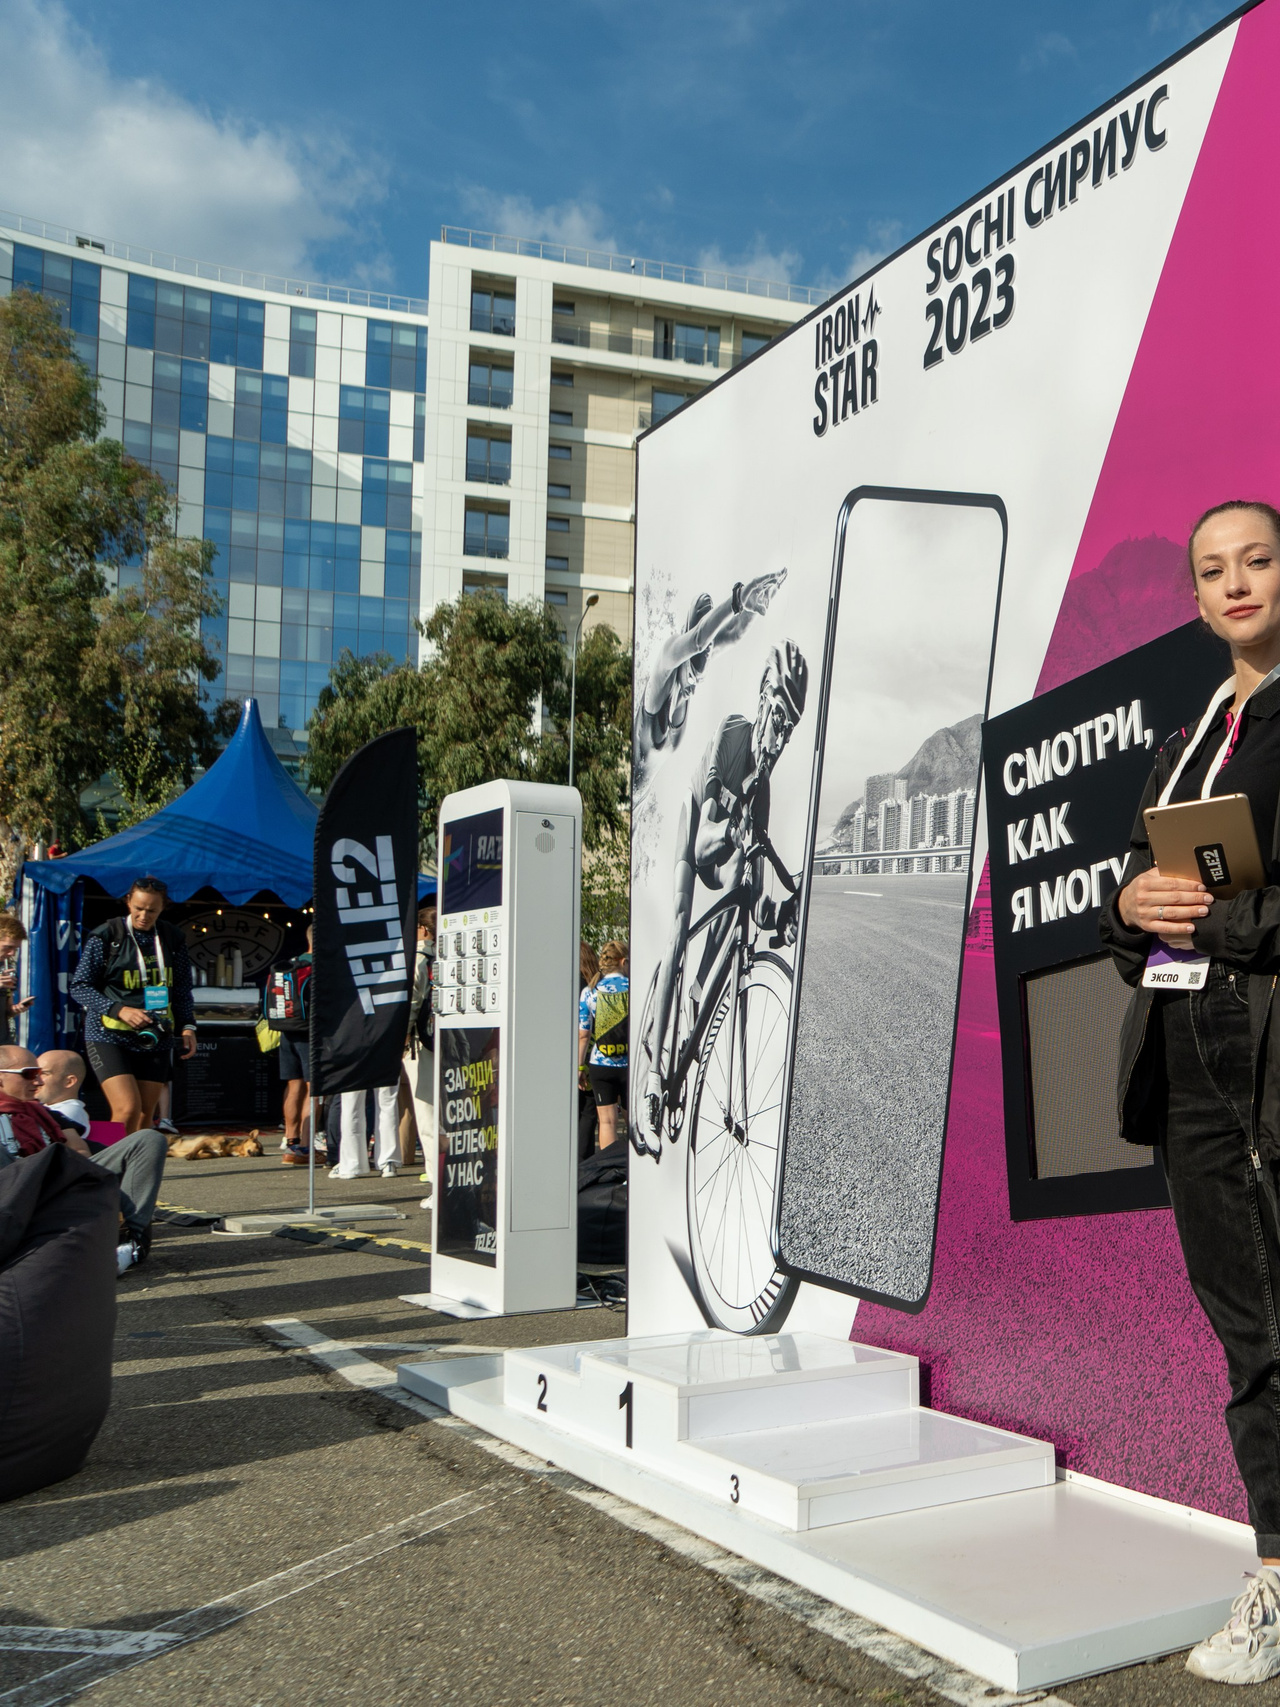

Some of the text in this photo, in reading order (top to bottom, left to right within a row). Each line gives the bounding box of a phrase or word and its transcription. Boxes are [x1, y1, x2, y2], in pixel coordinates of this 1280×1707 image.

[926, 84, 1169, 294] SOCHI СИРИУС
[923, 252, 1016, 370] 2023
[815, 292, 861, 369] IRON
[813, 338, 879, 437] STAR
[1003, 699, 1154, 797] СМОТРИ,
[1006, 801, 1075, 865] КАК
[1202, 849, 1225, 882] TELE2
[331, 835, 408, 1015] TELE2
[1011, 886, 1033, 933] Я
[194, 919, 270, 939] SURF
[493, 934, 498, 947] 3
[450, 963, 498, 979] 4 5 6
[1150, 972, 1179, 983] ЭКСПО
[450, 992, 497, 1007] 7 8 9
[197, 1042, 218, 1051] ENU
[444, 1059, 494, 1093] ЗАРЯДИ
[445, 1091, 482, 1125] СВОЙ
[446, 1125, 498, 1156] ТЕЛЕФОН
[446, 1160, 484, 1188] У НАС
[537, 1373, 548, 1413] 2
[619, 1381, 634, 1449] 1
[730, 1474, 740, 1504] 3
